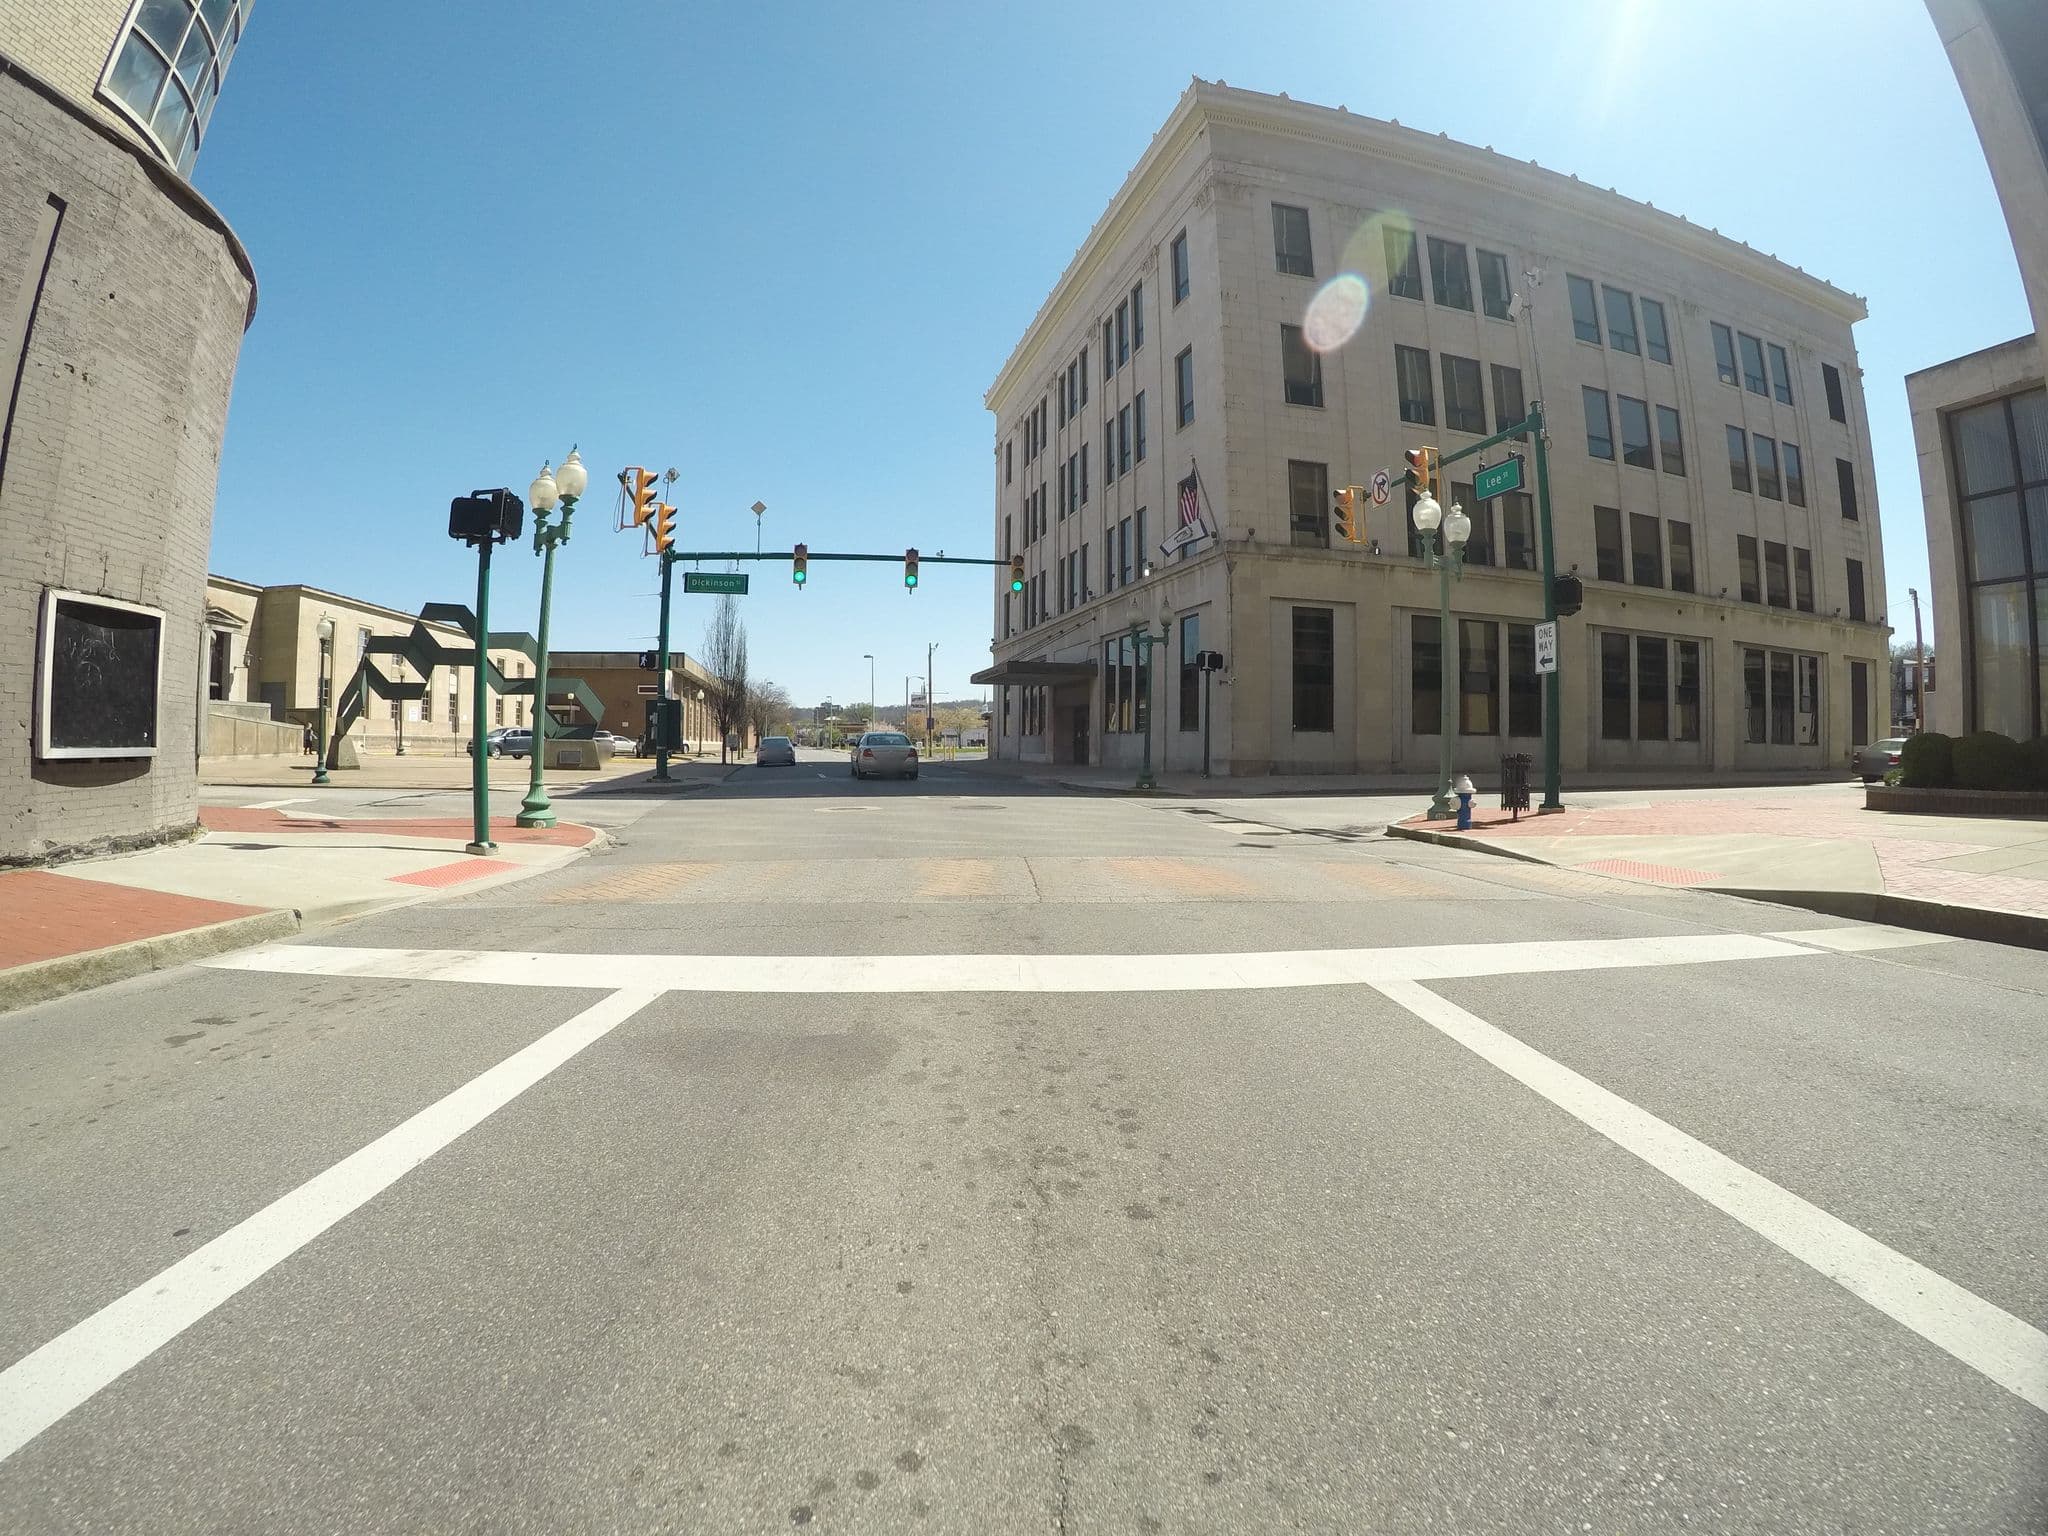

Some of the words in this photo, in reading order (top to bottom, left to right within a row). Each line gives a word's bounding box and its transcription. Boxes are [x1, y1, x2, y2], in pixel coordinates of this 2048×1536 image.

[1486, 475, 1502, 488] Lee
[691, 578, 735, 587] Dickinson
[1538, 626, 1553, 639] ONE
[1538, 639, 1553, 652] WAY
